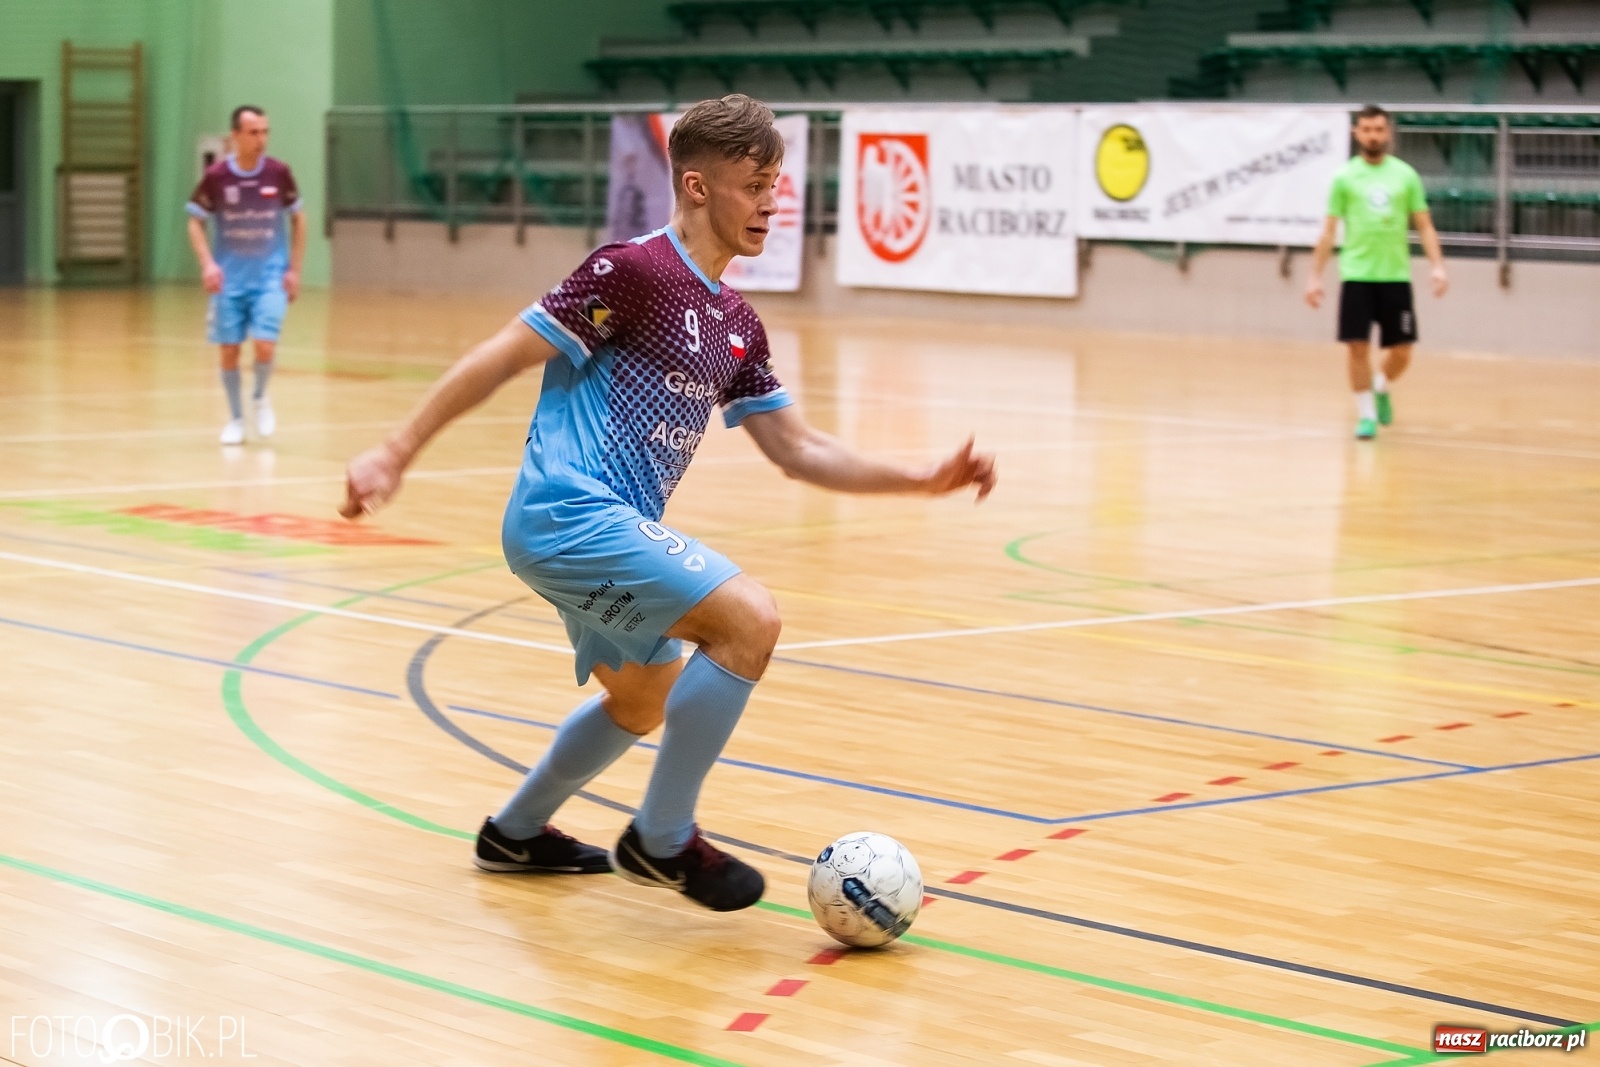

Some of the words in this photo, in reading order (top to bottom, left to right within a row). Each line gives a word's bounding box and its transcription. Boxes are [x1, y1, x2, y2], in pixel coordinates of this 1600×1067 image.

[952, 163, 1052, 193] MIASTO
[938, 203, 1067, 238] RACIBÓRZ
[684, 308, 701, 353] 9
[664, 371, 720, 405] Geo-
[637, 520, 688, 556] 9
